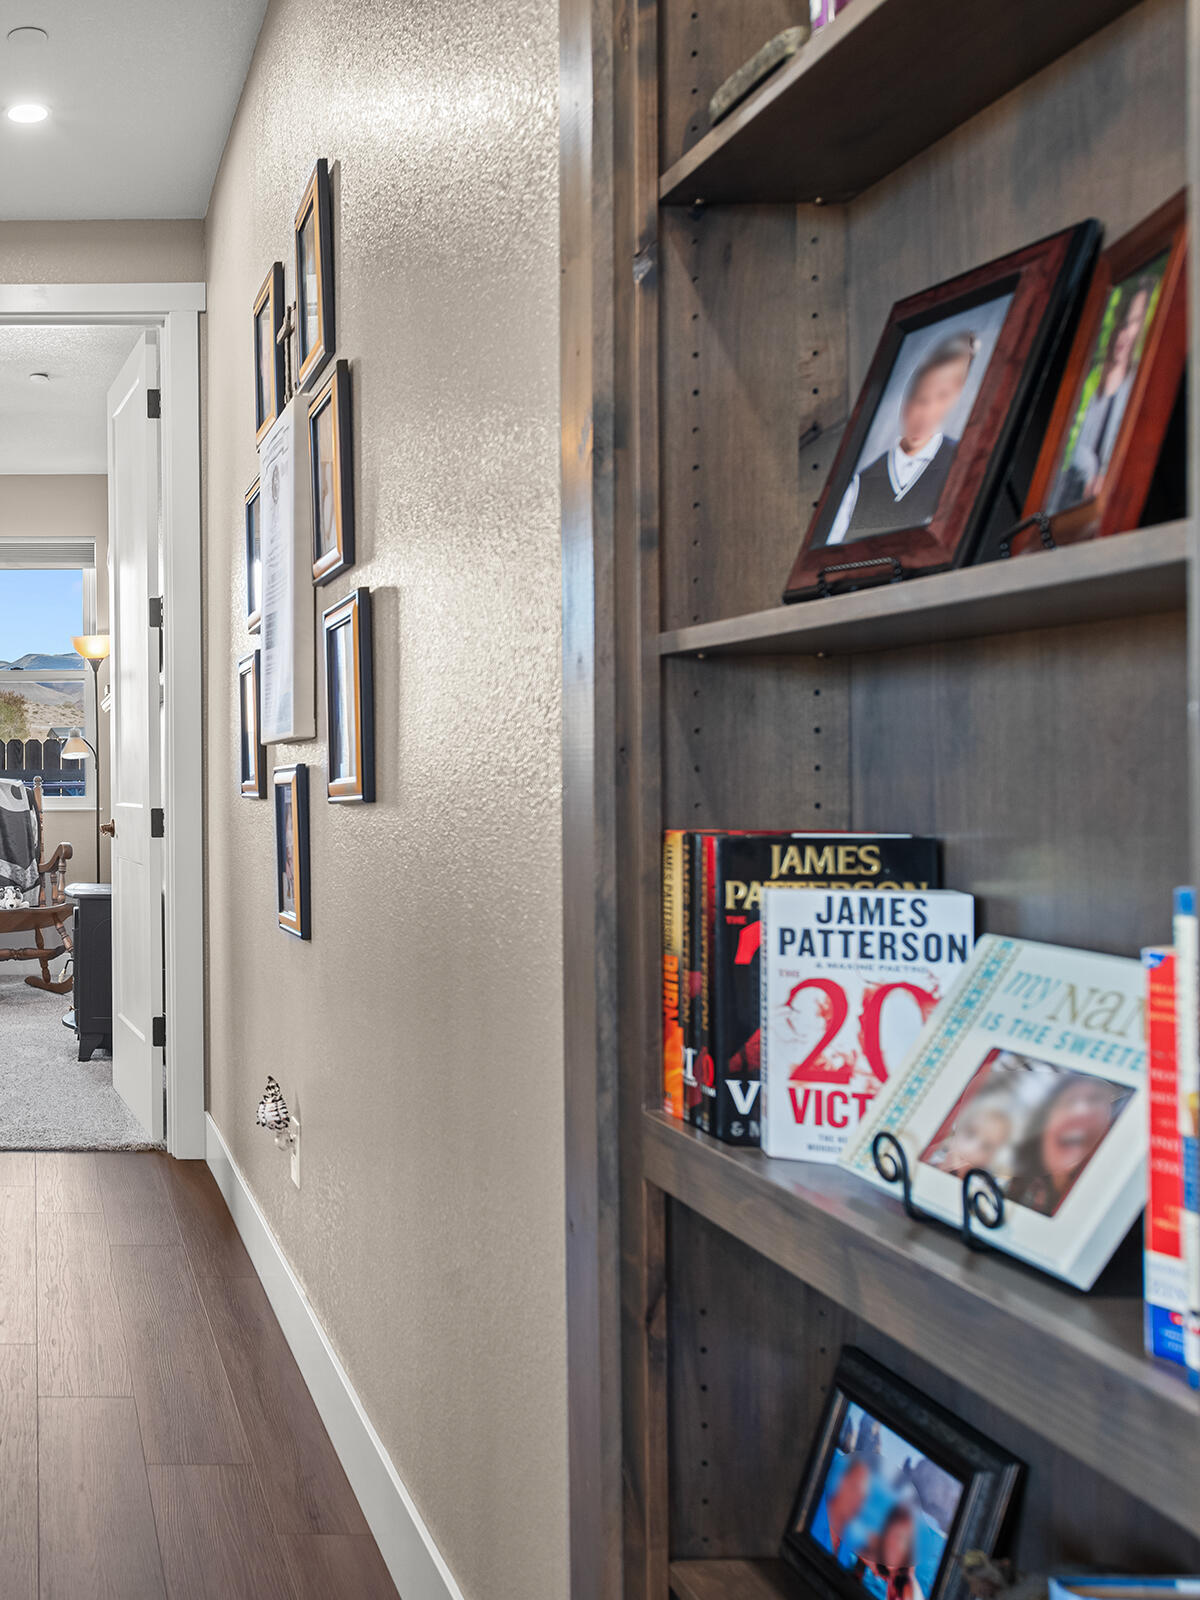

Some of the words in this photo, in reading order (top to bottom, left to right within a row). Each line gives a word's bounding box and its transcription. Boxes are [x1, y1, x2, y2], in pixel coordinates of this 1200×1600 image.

[770, 844, 881, 880] JAMES
[815, 896, 928, 928] JAMES
[778, 927, 968, 964] PATTERSON
[1004, 969, 1062, 1011] my
[979, 1010, 1005, 1032] IS
[1007, 1017, 1052, 1045] THE
